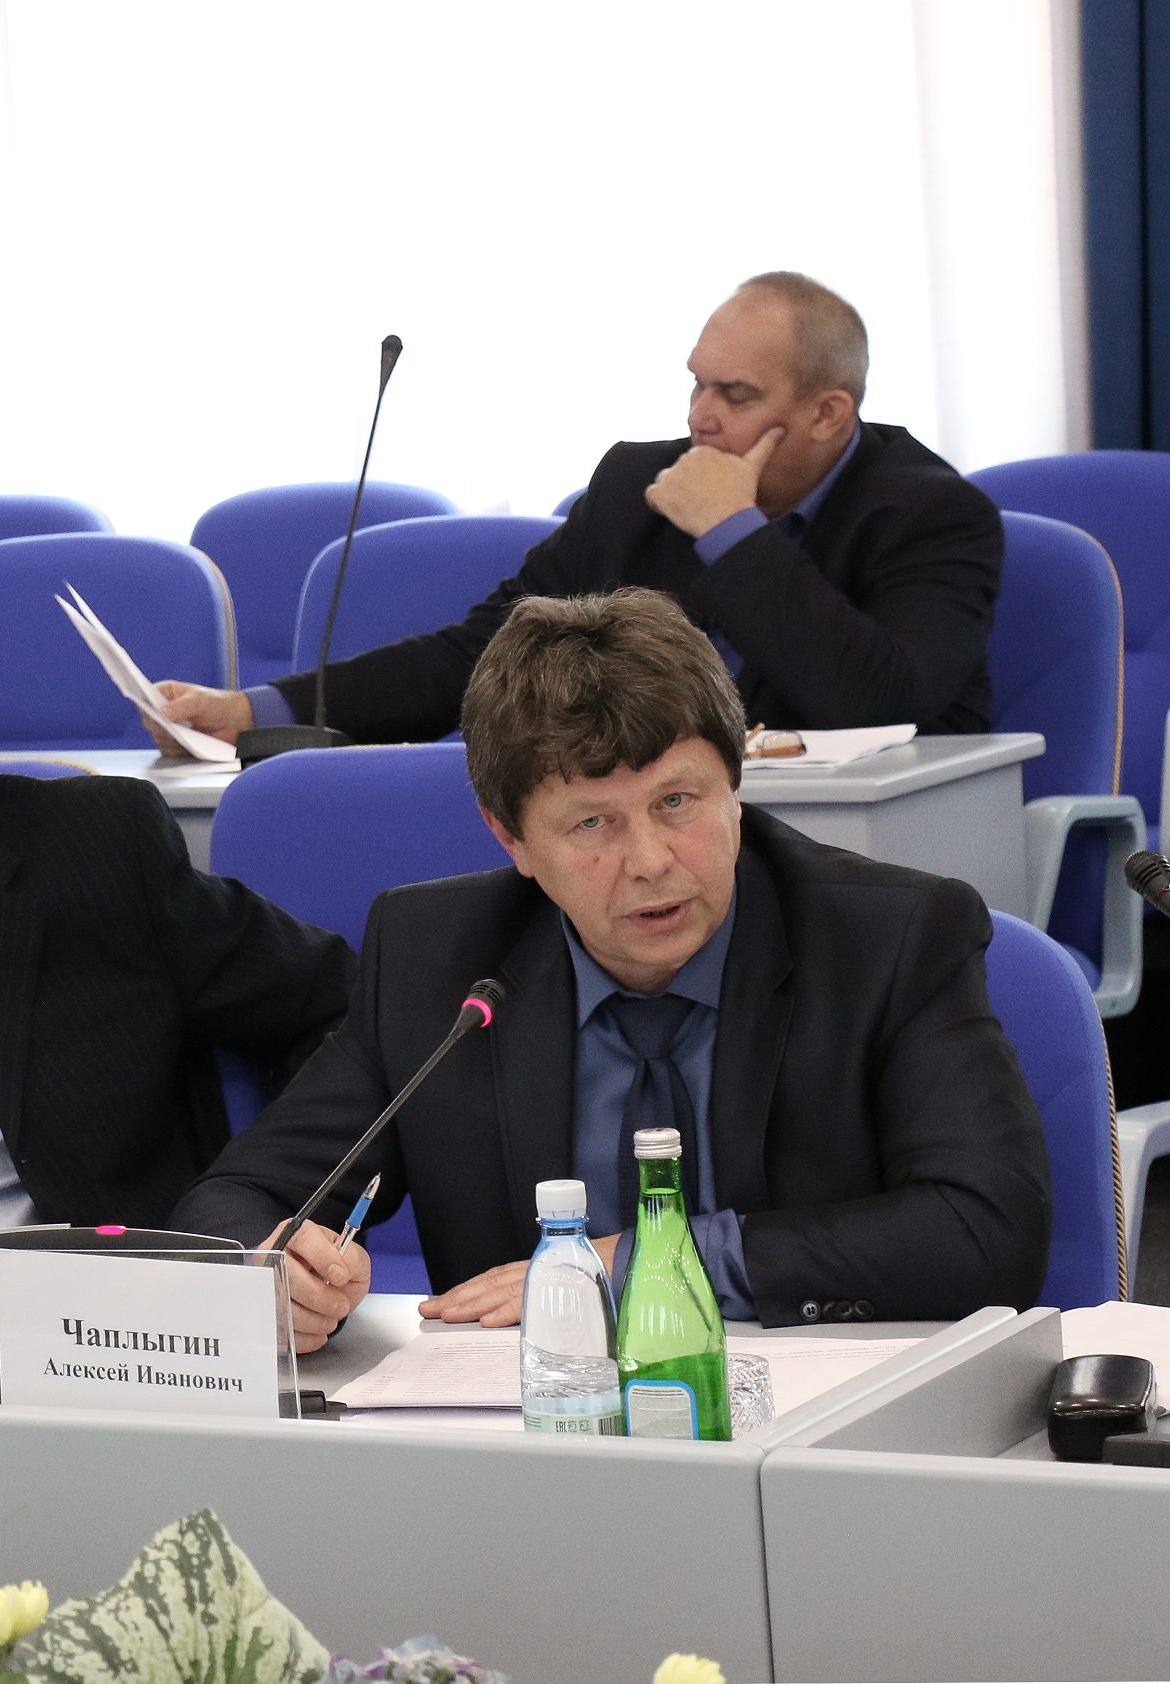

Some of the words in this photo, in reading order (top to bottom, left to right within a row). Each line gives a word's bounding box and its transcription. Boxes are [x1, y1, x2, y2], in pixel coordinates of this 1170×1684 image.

[60, 1317, 222, 1357] Чаплыгин
[43, 1356, 129, 1383] Алексей
[136, 1364, 244, 1392] Иванович
